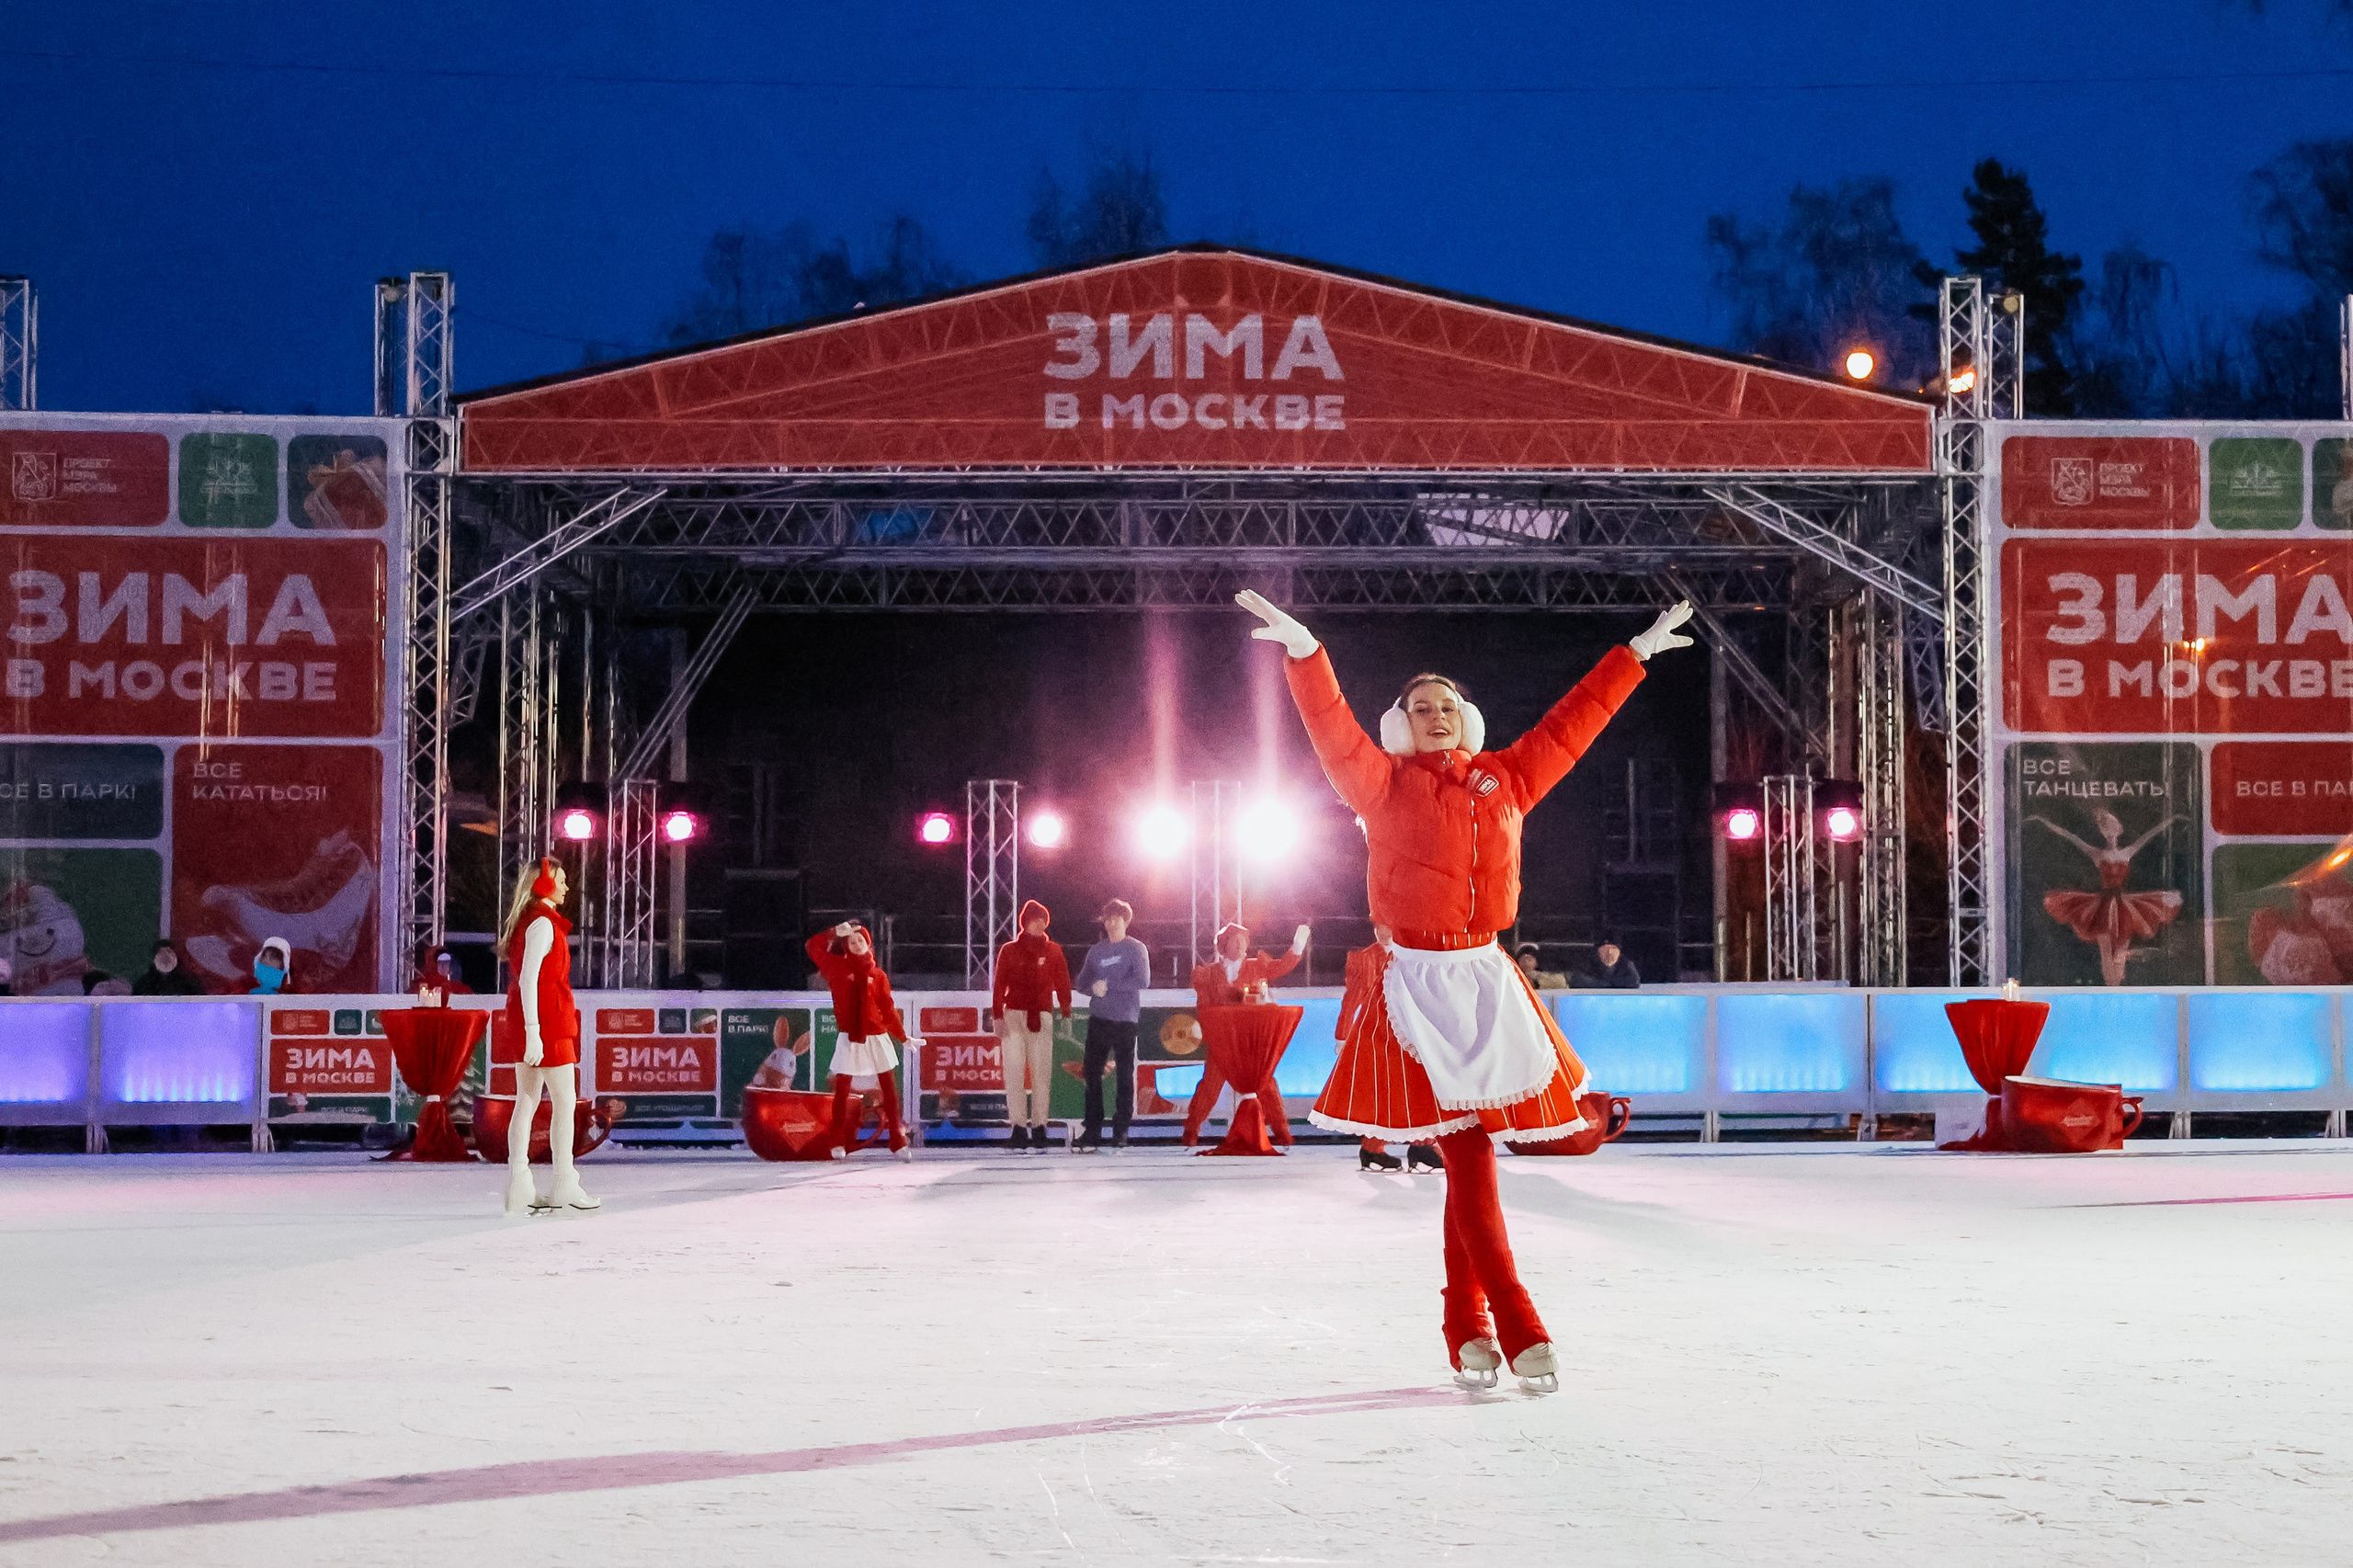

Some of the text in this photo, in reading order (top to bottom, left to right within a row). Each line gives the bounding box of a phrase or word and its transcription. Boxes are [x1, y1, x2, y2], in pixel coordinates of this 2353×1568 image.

[1043, 312, 1345, 381] ЗИМА
[1044, 392, 1346, 431] В МОСКВЕ
[7, 570, 337, 646] ЗИМА
[2046, 572, 2353, 645] ЗИМА
[6, 659, 337, 700] В МОСКВЕ
[2048, 659, 2353, 699] В МОСКВЕ
[193, 763, 243, 778] ВСЕ
[2023, 759, 2072, 776] ВСЕ
[0, 783, 136, 800] СЕ В ПАРК!
[2235, 780, 2353, 797] ВСЕ В ПА
[286, 1048, 376, 1069] ЗИМА
[611, 1047, 701, 1068] ЗИМА
[935, 1045, 1002, 1066] ЗИМ
[285, 1072, 376, 1084] В МОСКВЕ
[611, 1070, 701, 1083] В МОСКВЕ
[935, 1069, 1003, 1082] В МОСК
